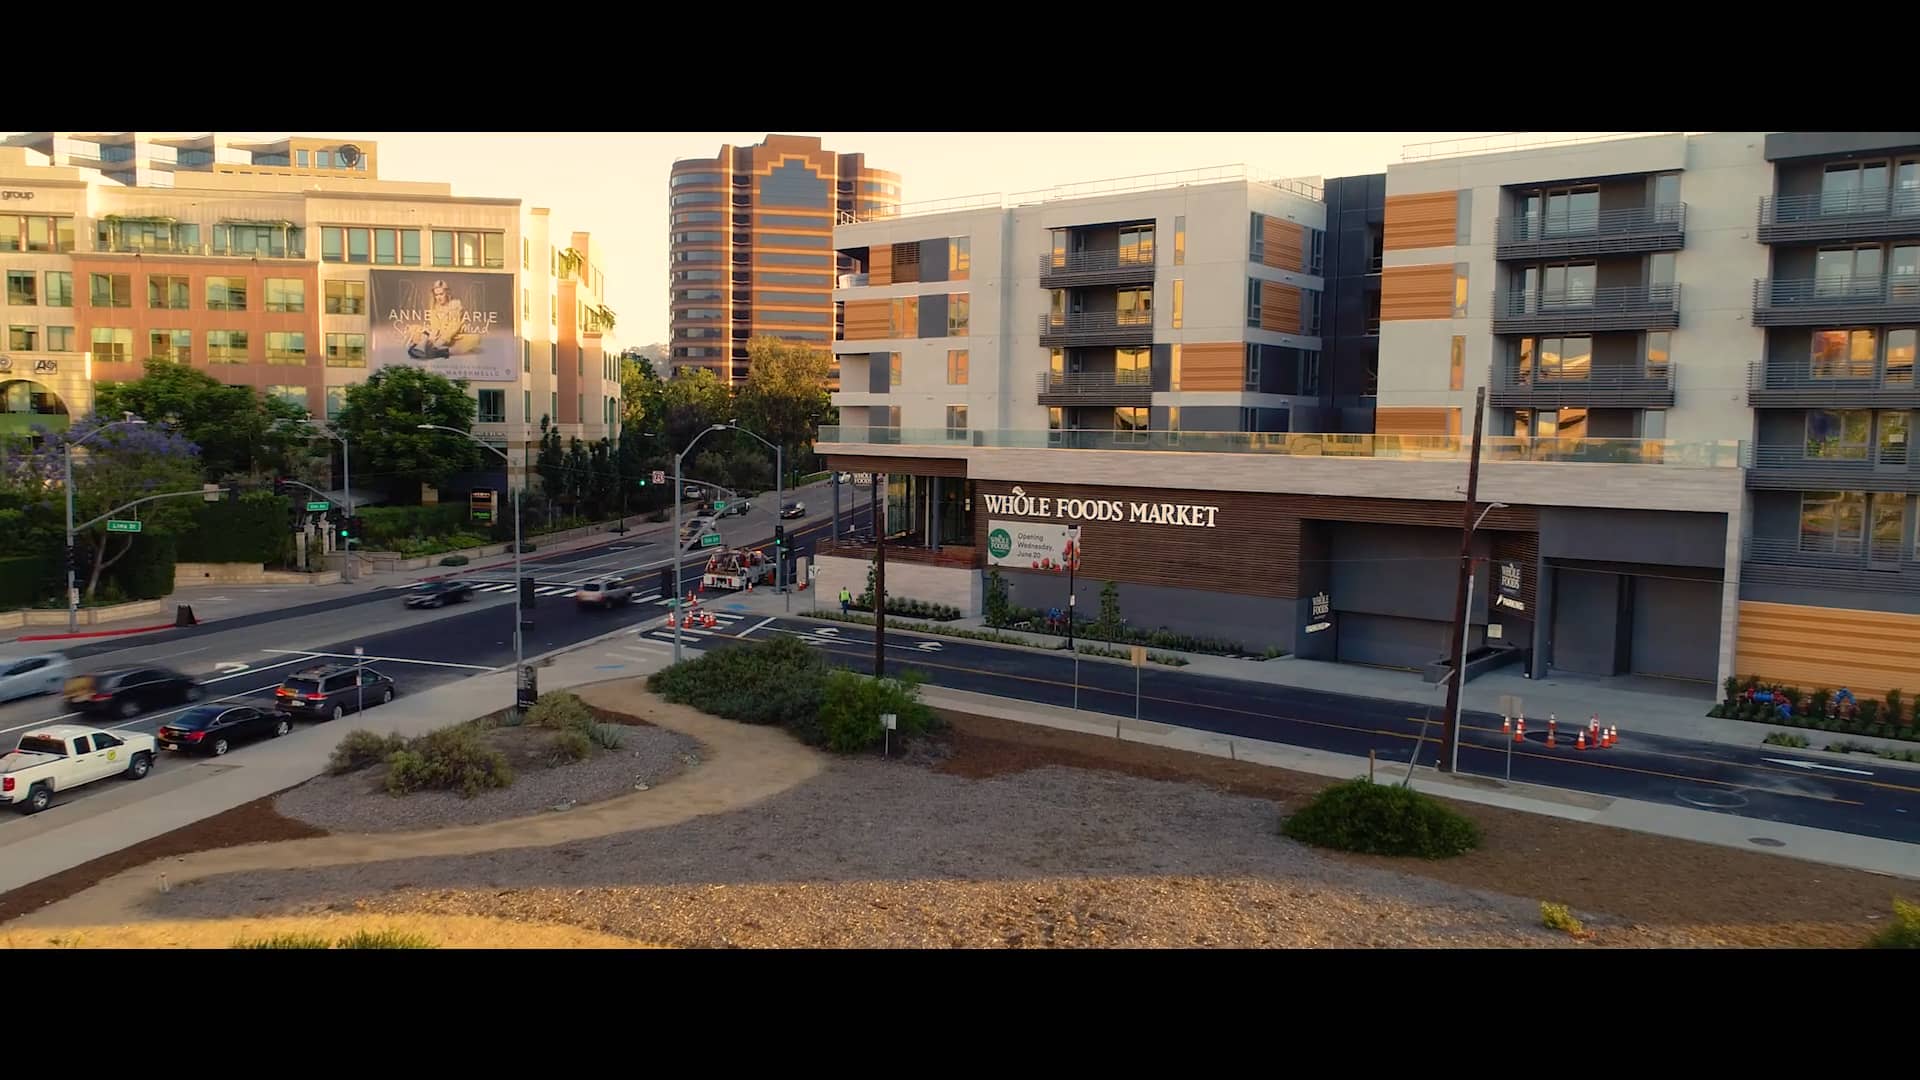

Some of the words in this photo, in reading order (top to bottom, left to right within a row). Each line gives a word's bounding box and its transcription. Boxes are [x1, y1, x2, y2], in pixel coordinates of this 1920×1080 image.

[2, 191, 34, 200] group
[984, 486, 1050, 517] WHOLE
[1056, 498, 1123, 521] FOODS
[1129, 502, 1219, 527] MARKET
[1018, 532, 1043, 542] Opening
[1017, 550, 1032, 558] June
